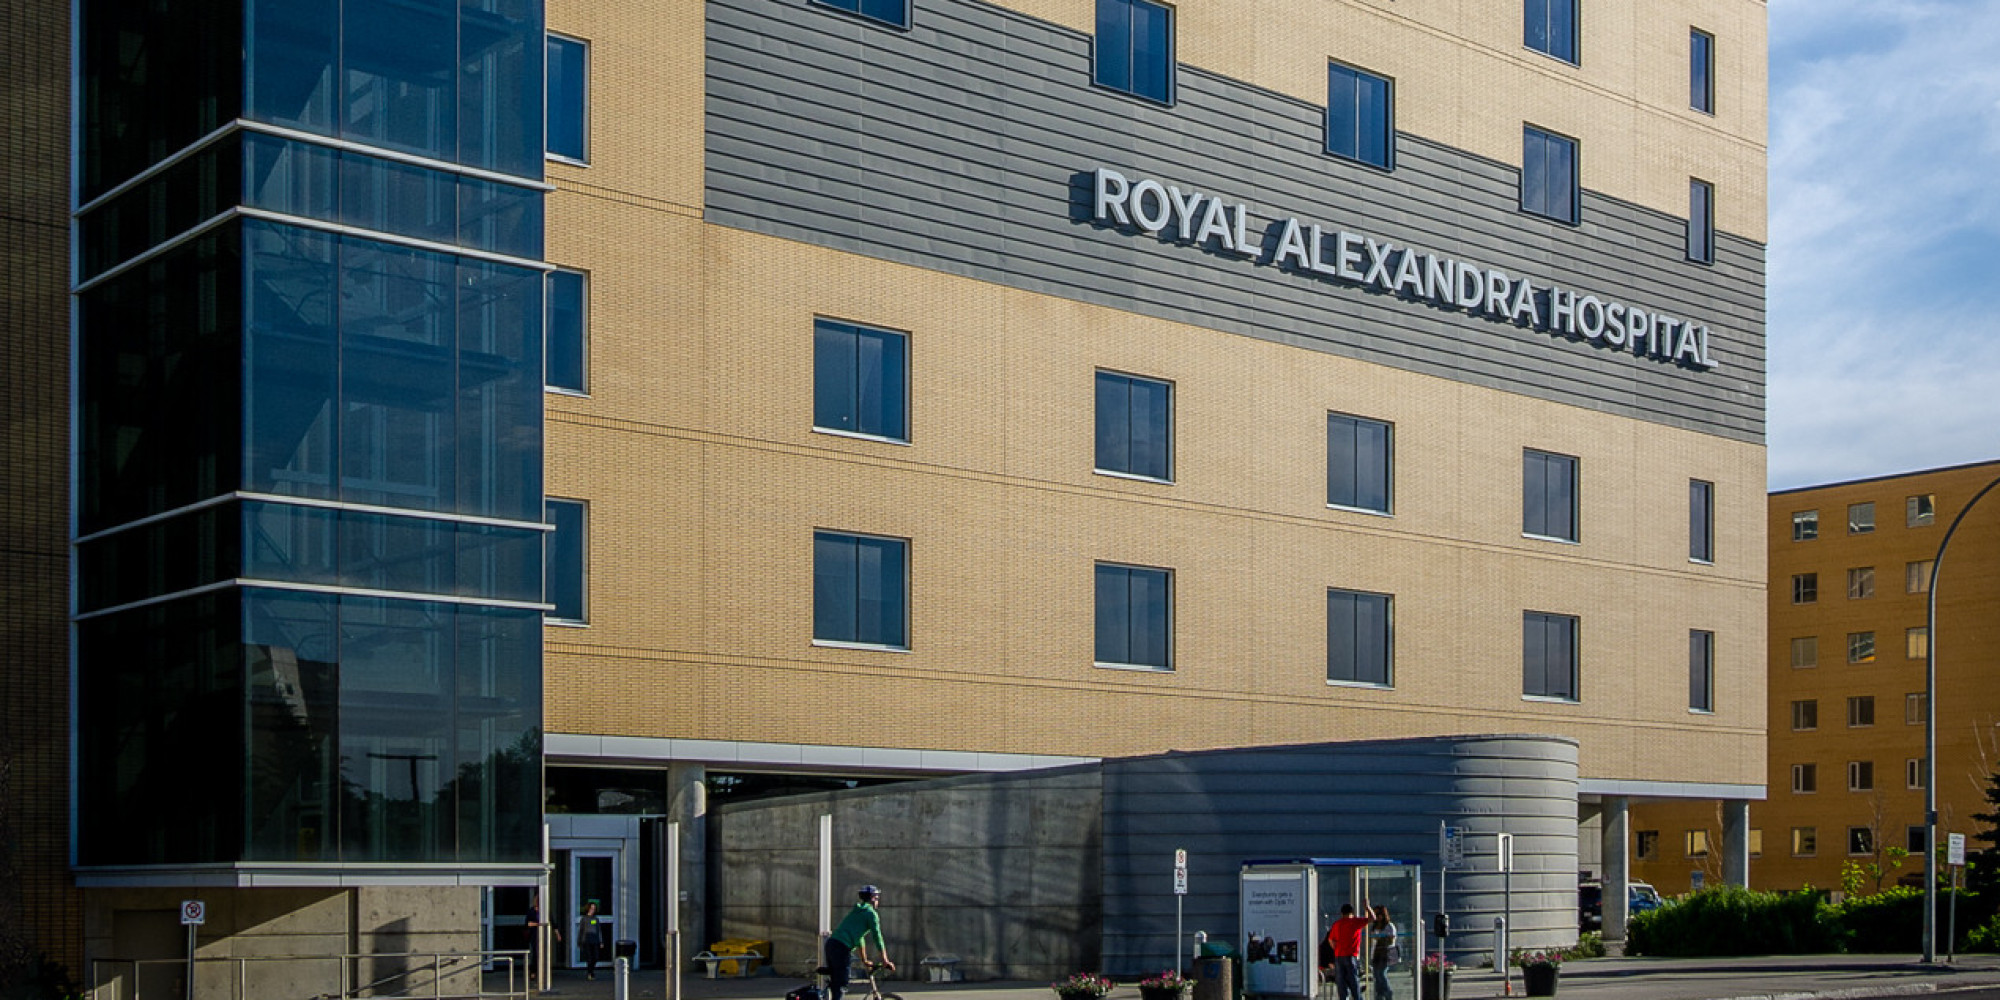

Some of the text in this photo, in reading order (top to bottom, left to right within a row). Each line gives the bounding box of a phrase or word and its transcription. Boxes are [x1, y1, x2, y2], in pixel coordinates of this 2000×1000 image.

[1095, 167, 1719, 368] ROYAL ALEXANDRA HOSPITAL
